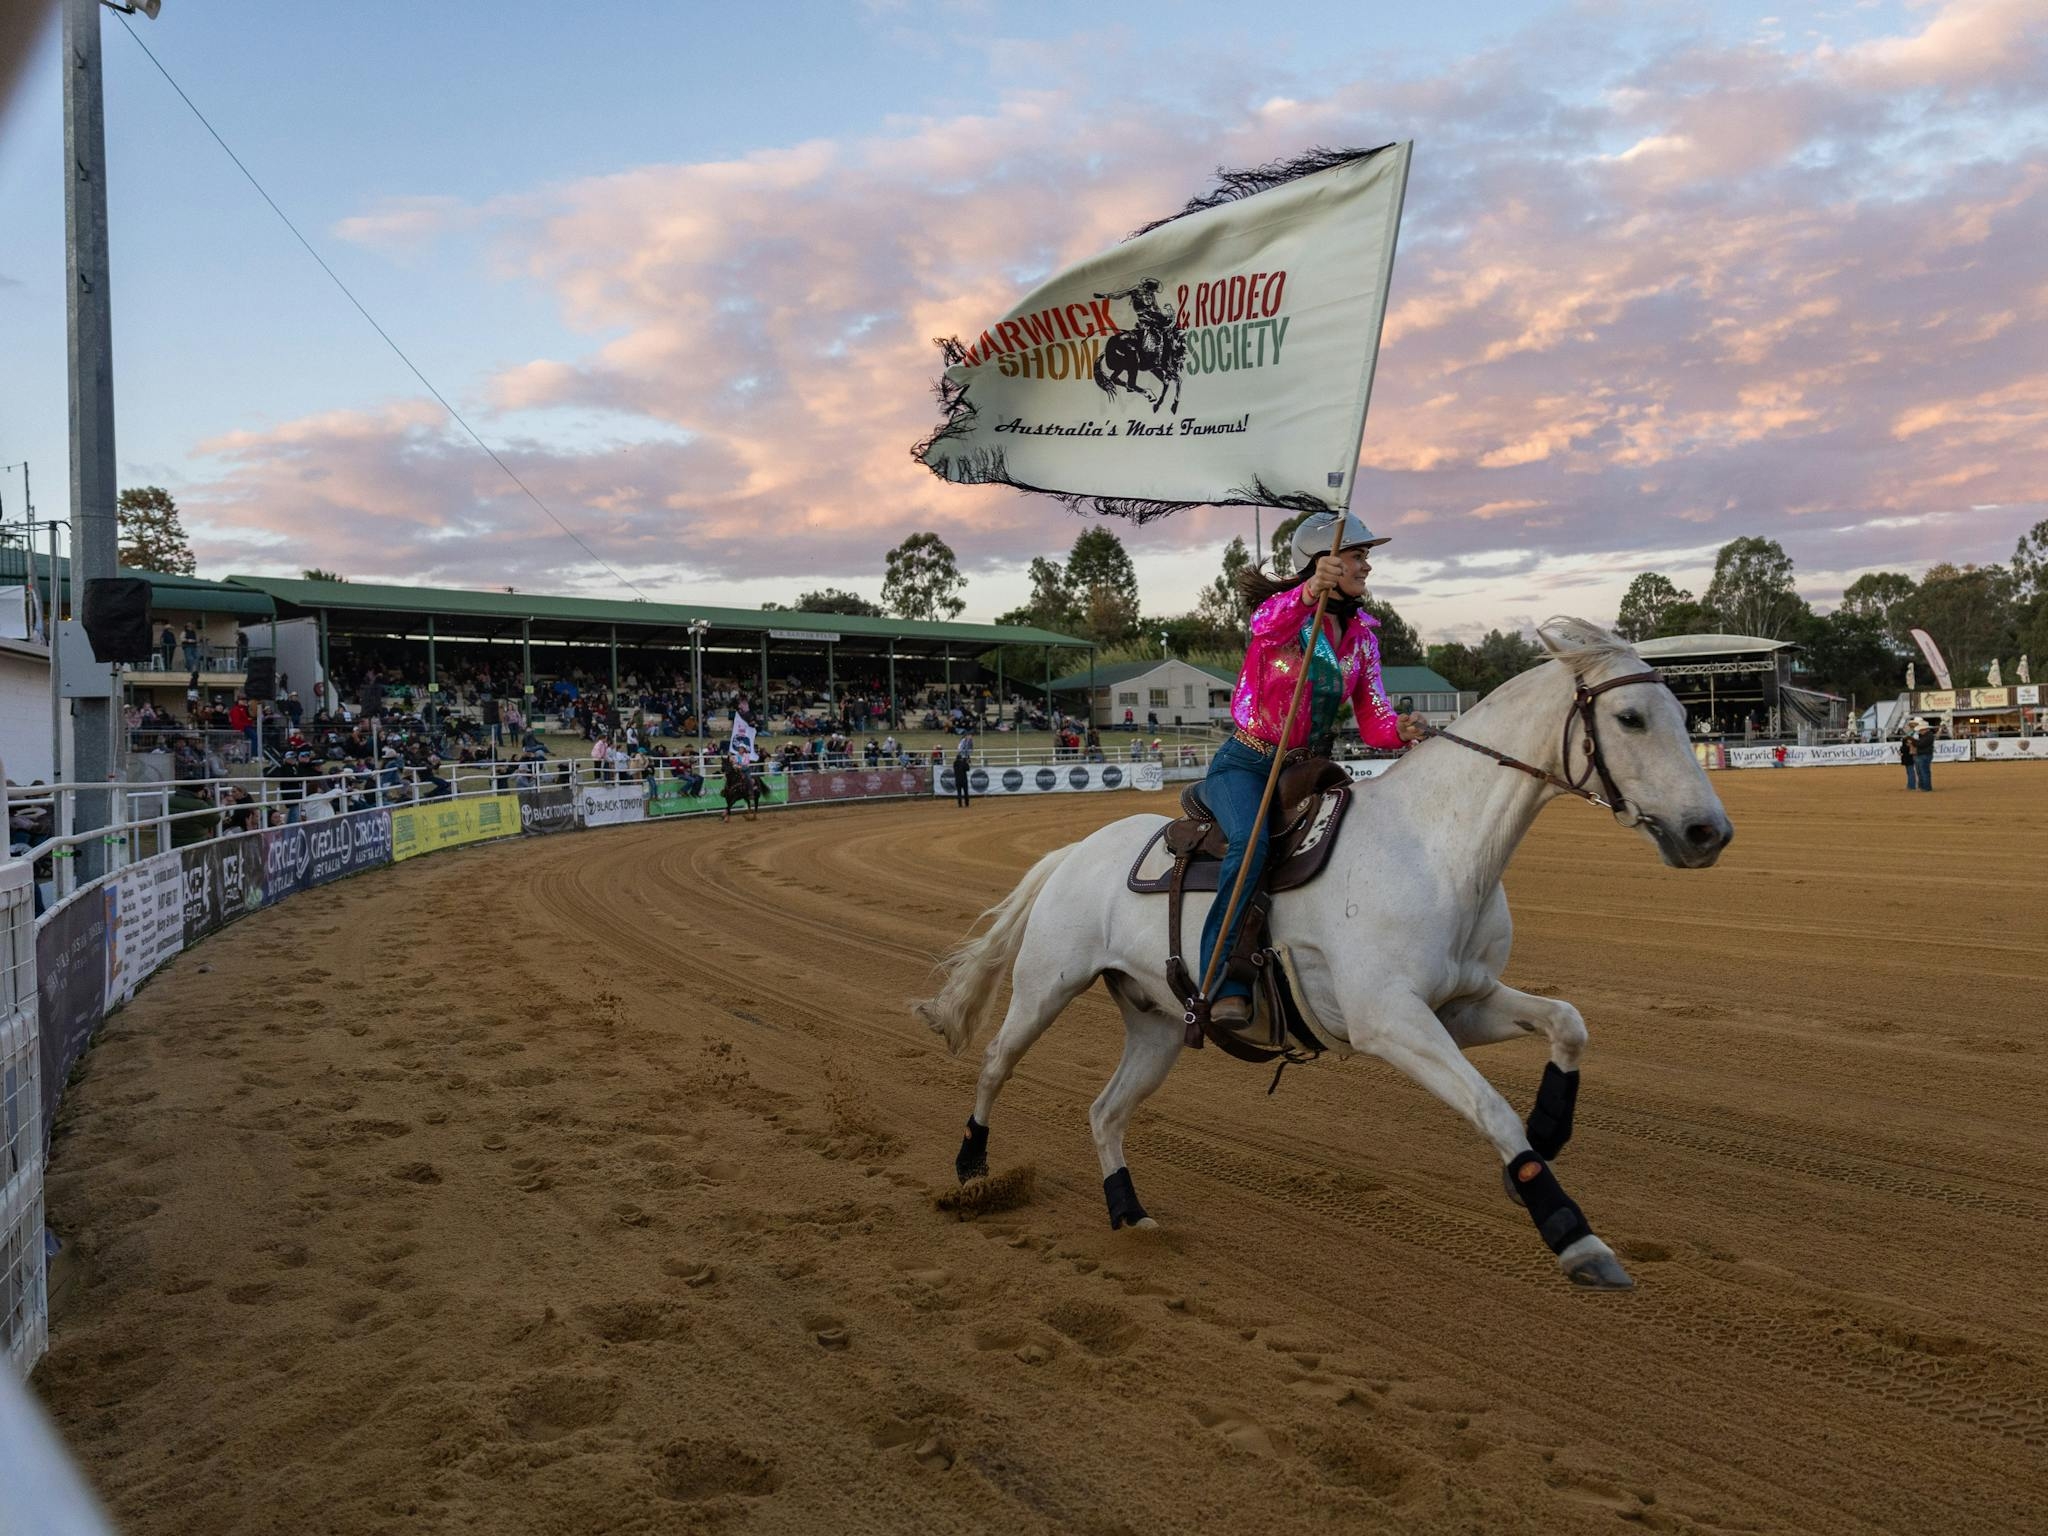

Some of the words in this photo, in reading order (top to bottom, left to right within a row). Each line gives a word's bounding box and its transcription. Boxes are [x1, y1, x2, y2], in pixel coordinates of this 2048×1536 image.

[1176, 284, 1191, 330] &
[1195, 271, 1287, 328] RODEO
[998, 339, 1099, 381] SHOW
[1186, 317, 1290, 376] SOCIETY
[994, 418, 1119, 437] Australia's
[1125, 419, 1174, 437] Most
[1180, 413, 1250, 437] Famous!
[1811, 747, 1857, 759] Warwick
[1940, 743, 1968, 756] Today
[596, 800, 619, 812] BLACK
[619, 798, 642, 810] TOYOTA
